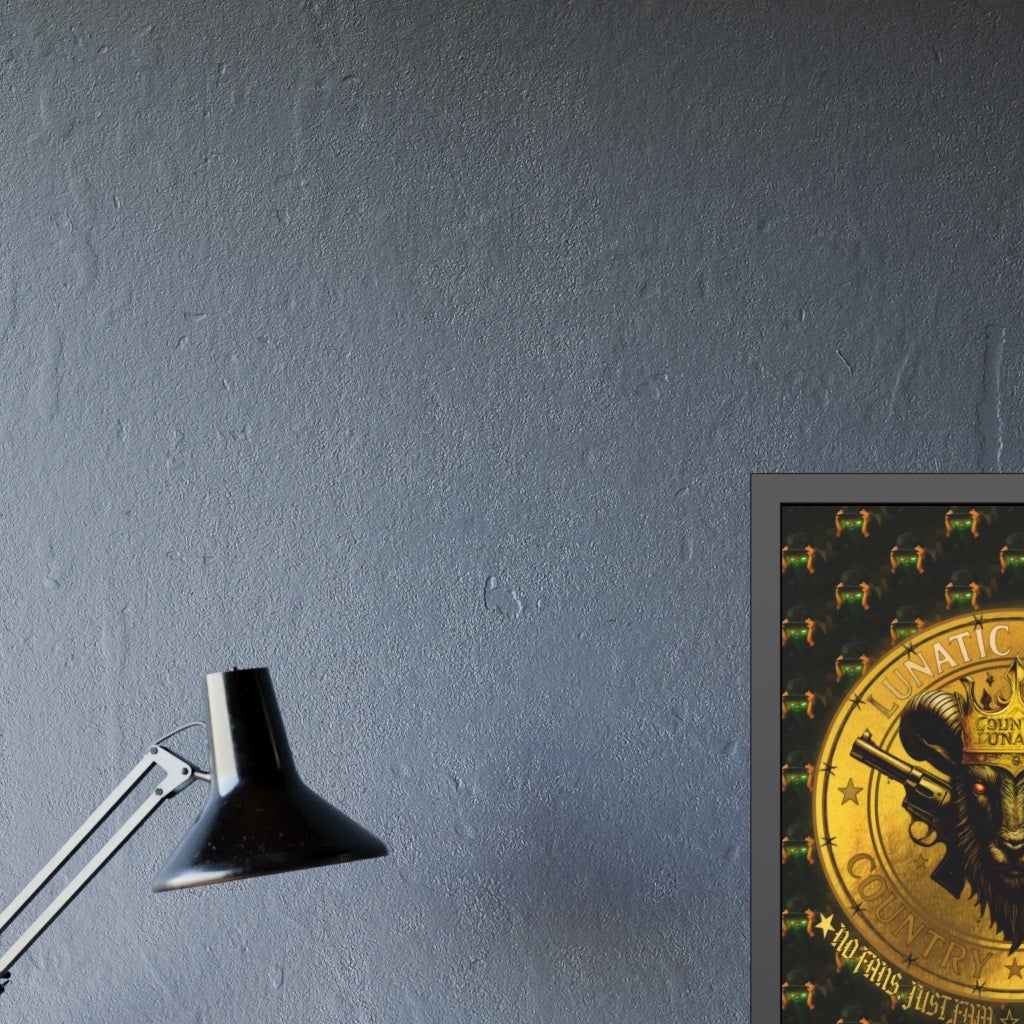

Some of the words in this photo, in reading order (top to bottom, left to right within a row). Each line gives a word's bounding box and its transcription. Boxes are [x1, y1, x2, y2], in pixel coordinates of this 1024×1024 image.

[867, 624, 1011, 720] LUNATIC
[846, 852, 994, 979] COUNTRY
[831, 922, 859, 959] NO
[901, 980, 952, 1021] JUST
